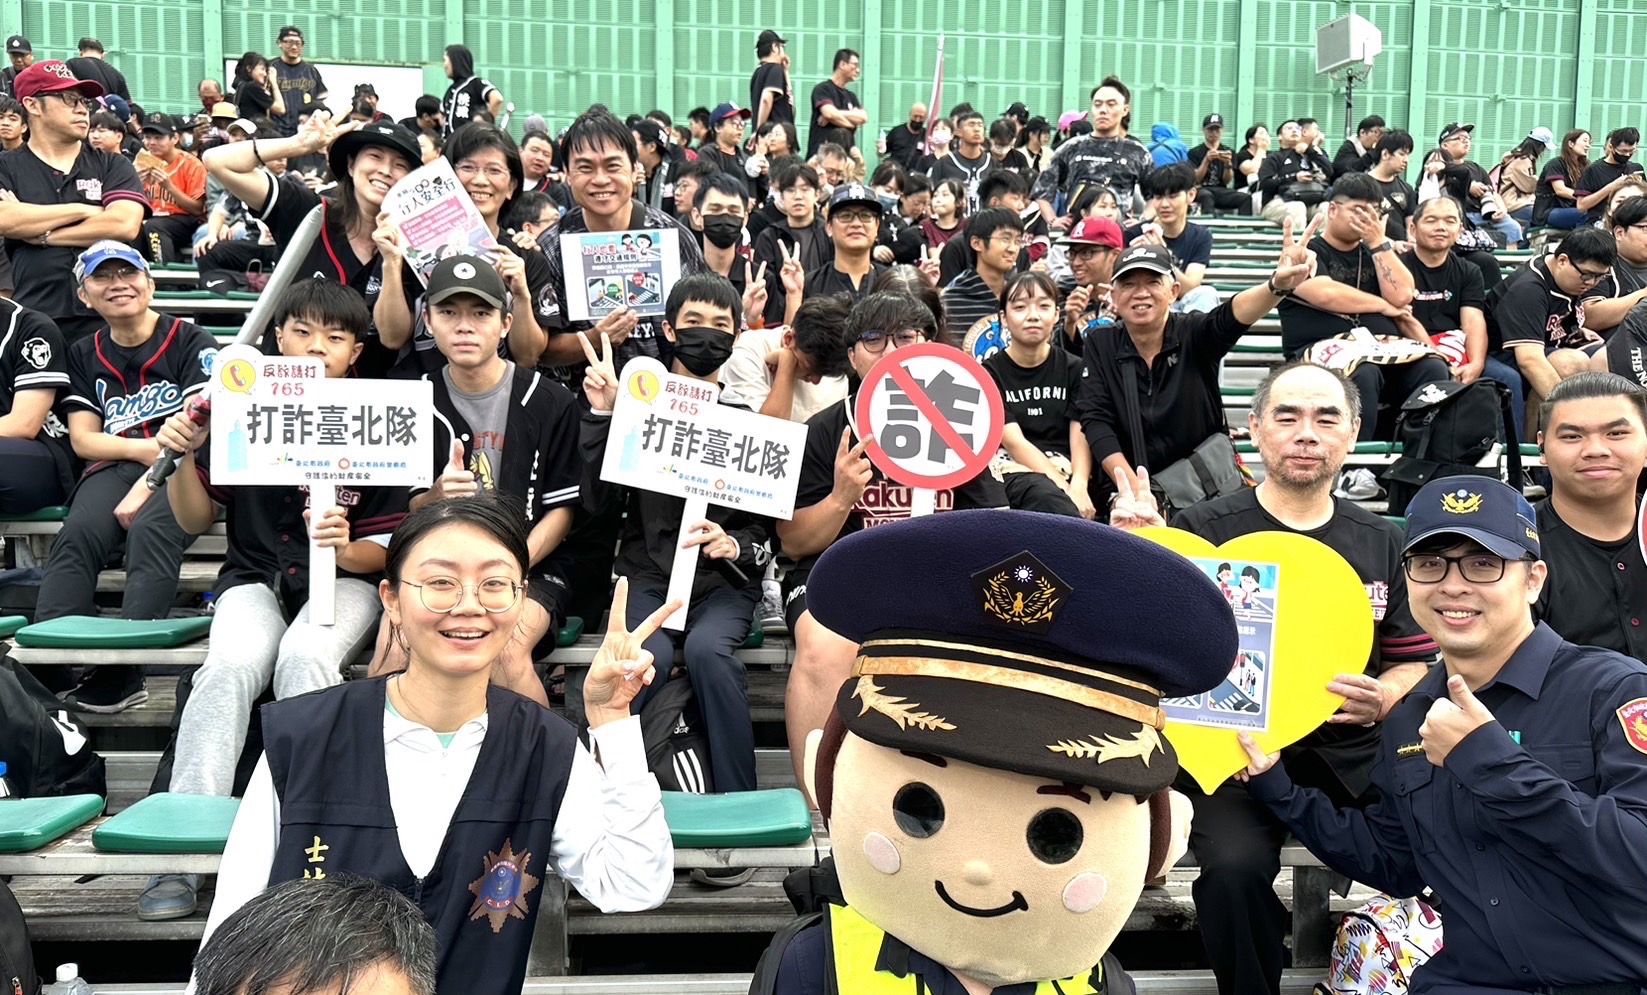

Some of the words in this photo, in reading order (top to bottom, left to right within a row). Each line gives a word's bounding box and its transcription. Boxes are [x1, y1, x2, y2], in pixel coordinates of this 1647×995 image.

[263, 364, 317, 379] 反詐請打
[665, 381, 713, 403] 反詐請打
[247, 403, 417, 446] 打詐臺北隊
[881, 366, 981, 466] 詐
[642, 414, 790, 480] 打詐臺北隊
